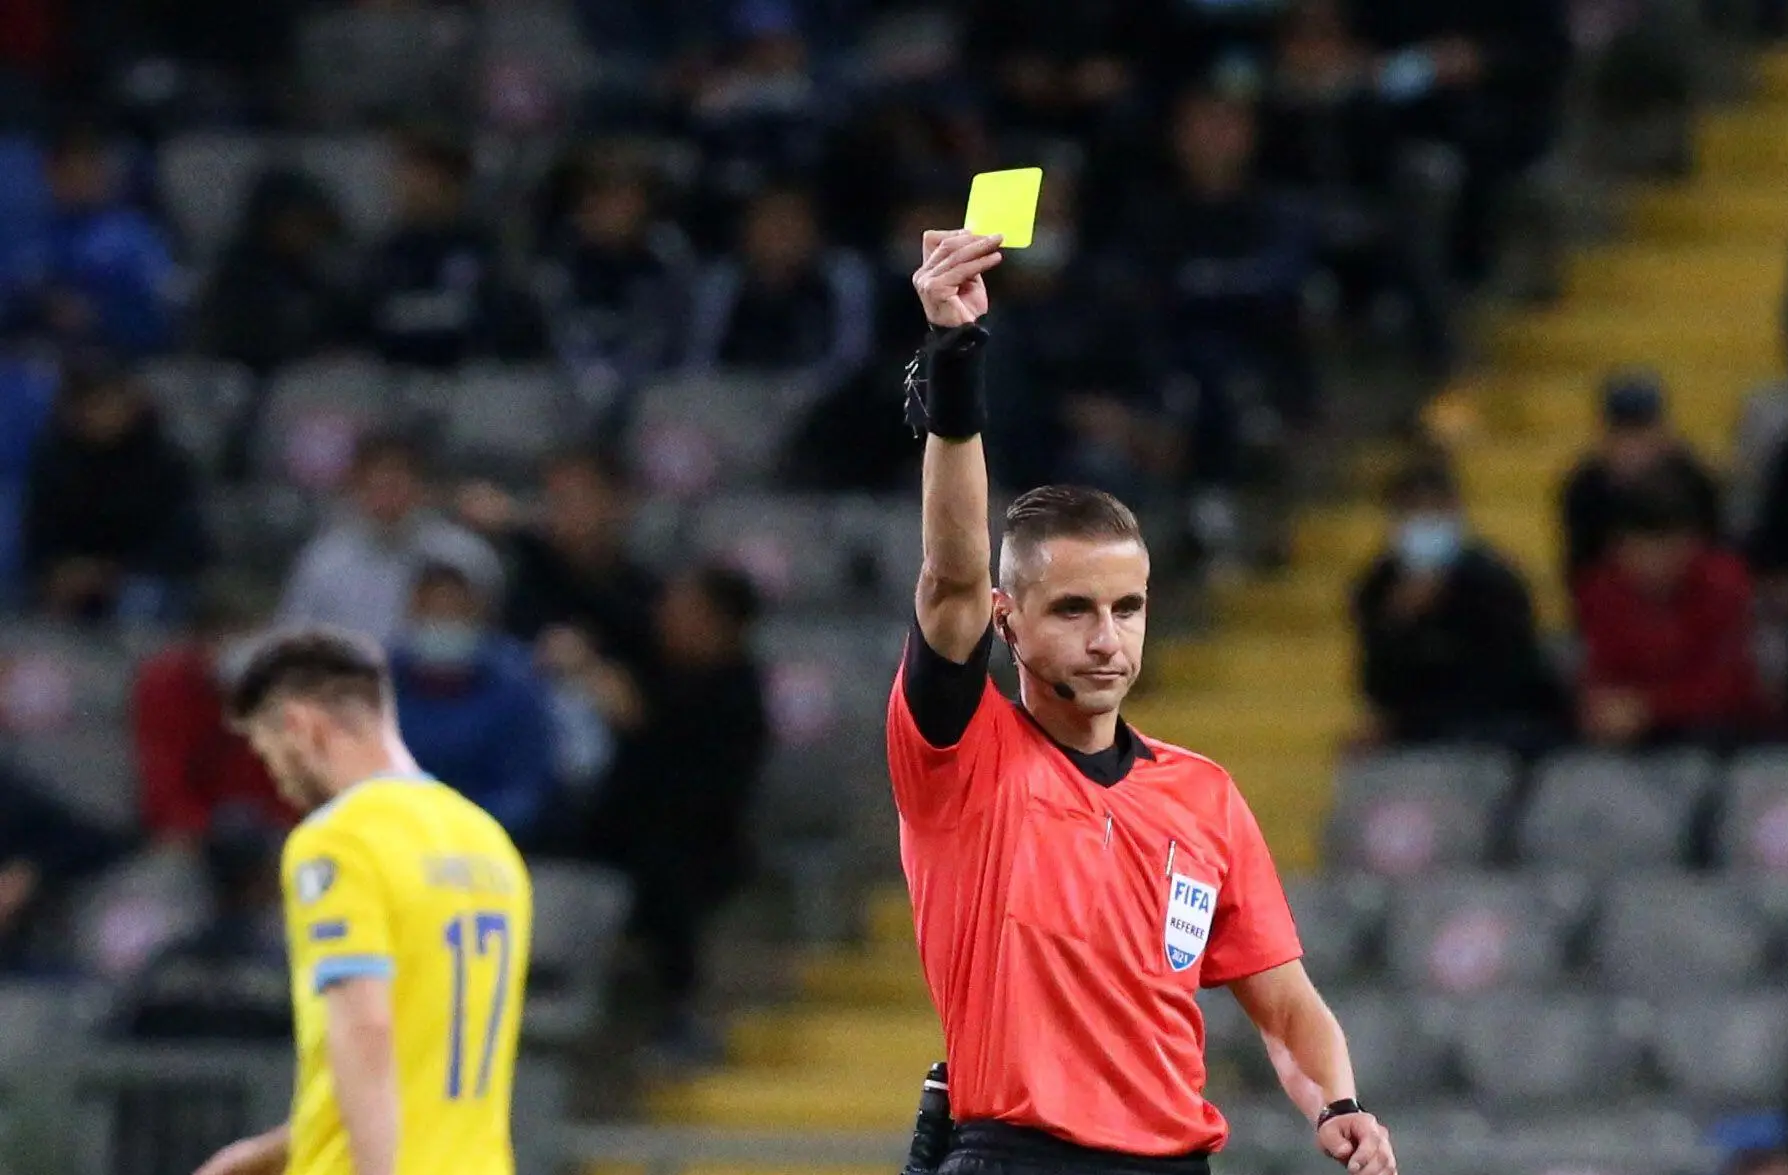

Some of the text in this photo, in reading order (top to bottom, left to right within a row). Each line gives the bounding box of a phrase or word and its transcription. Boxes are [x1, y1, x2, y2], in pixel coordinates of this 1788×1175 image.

[1174, 880, 1210, 914] FIFA
[1170, 917, 1205, 941] REFEREE
[446, 911, 508, 1101] 17
